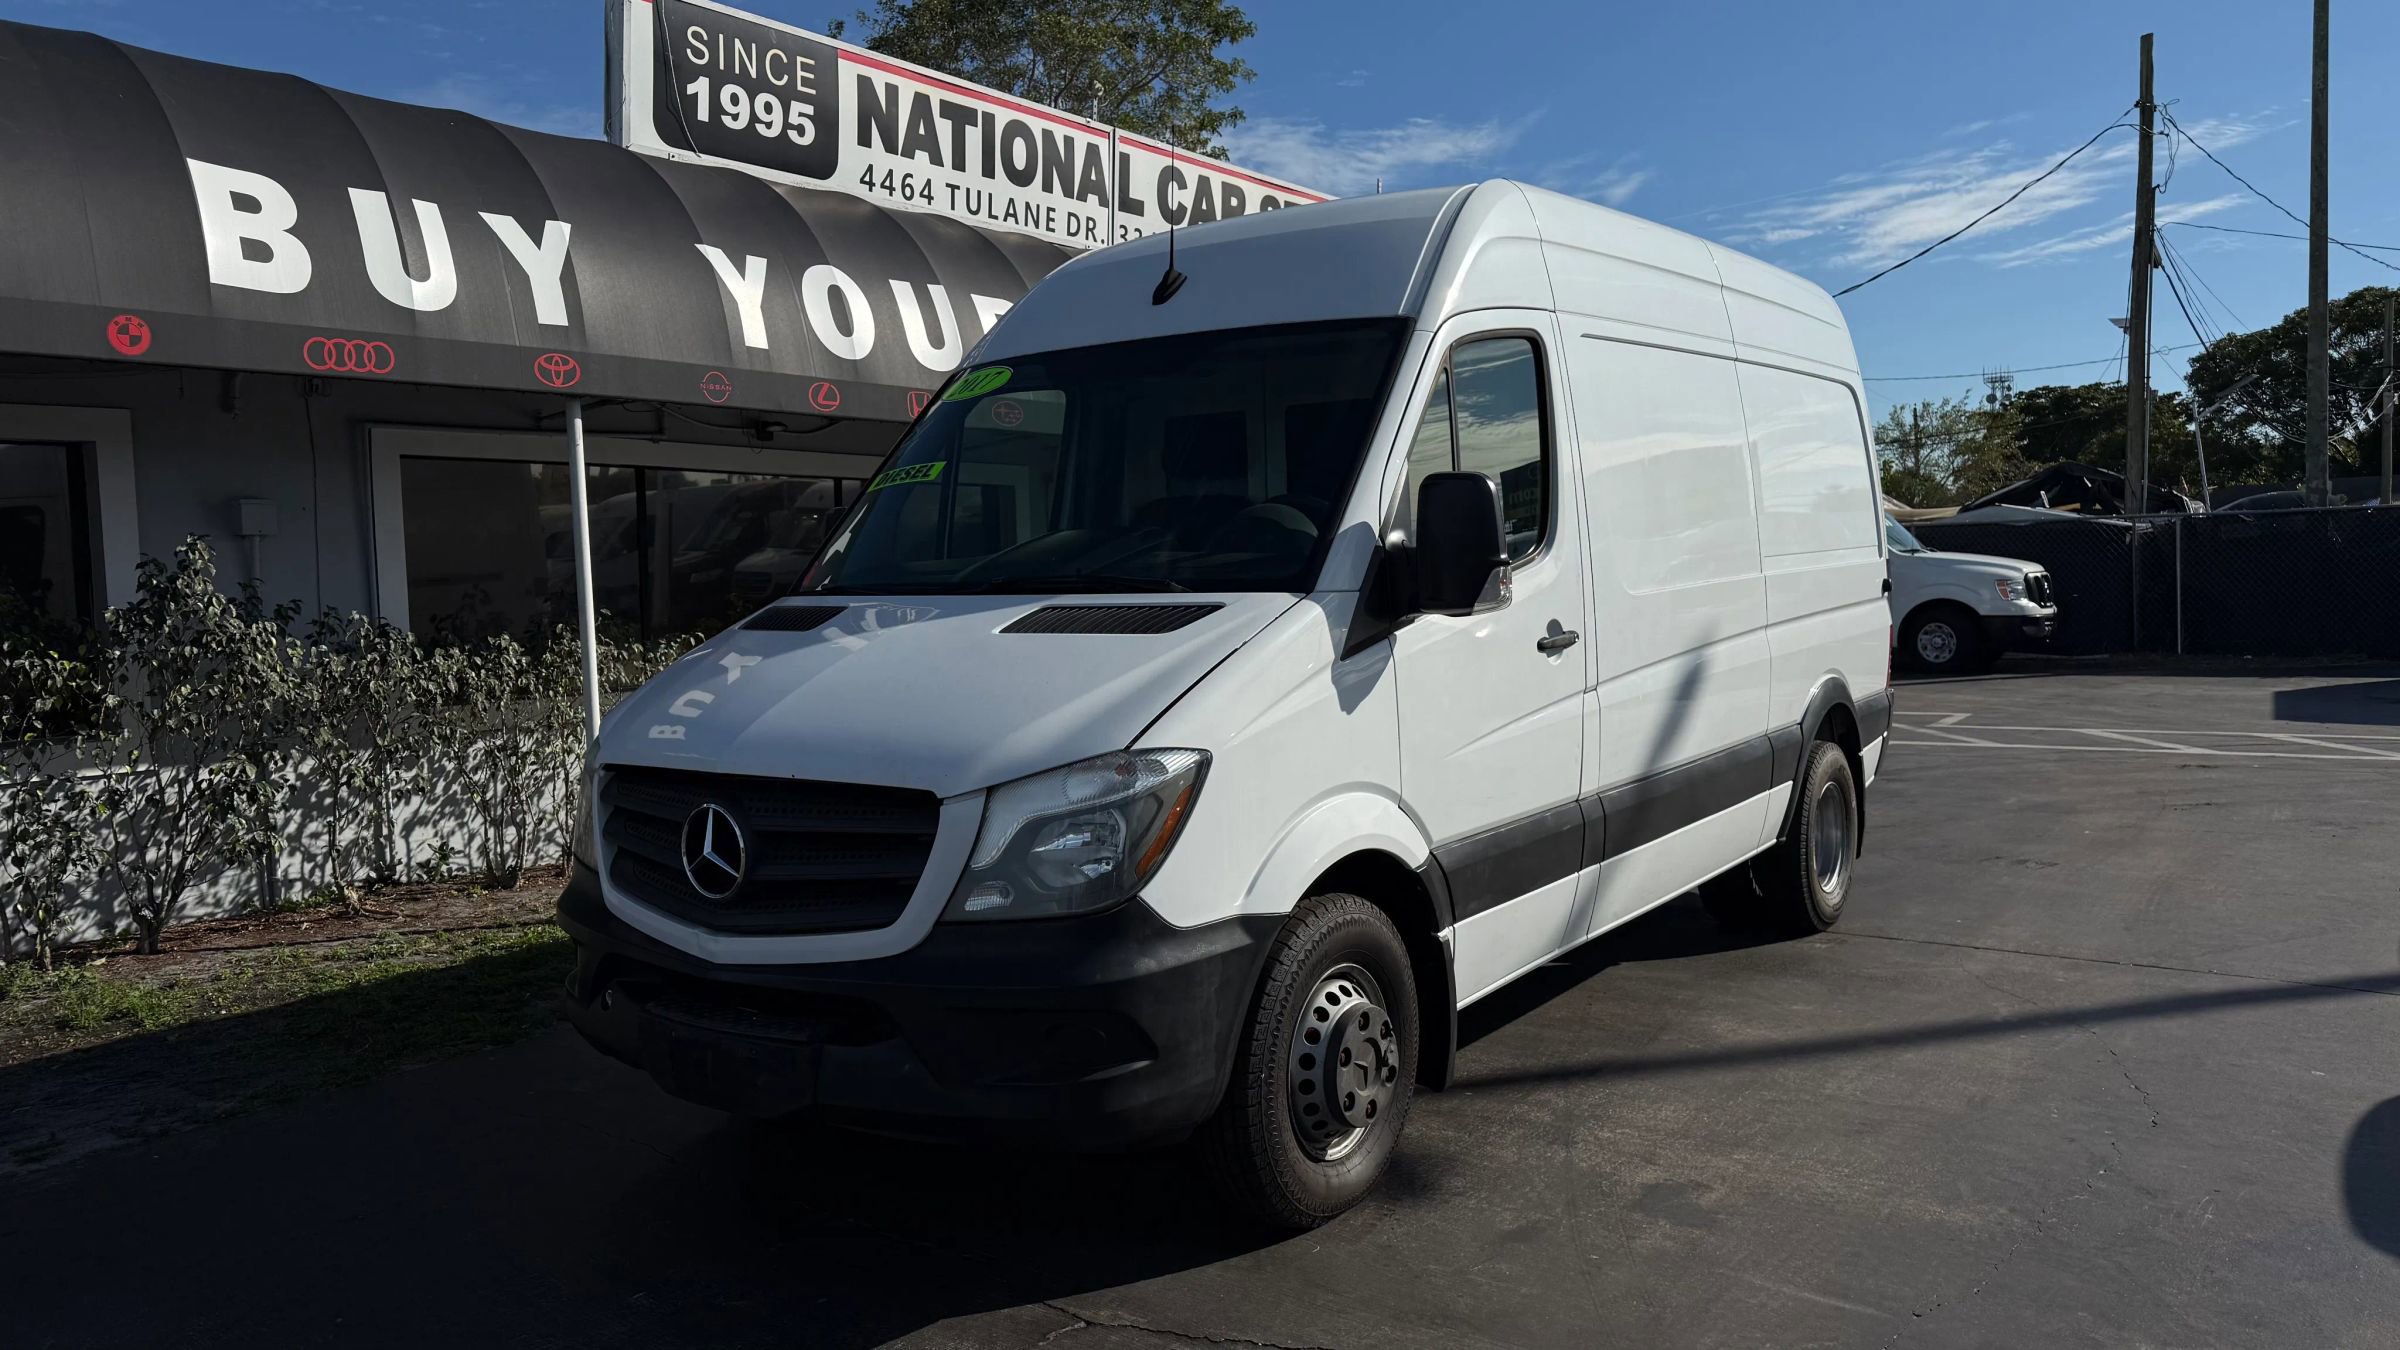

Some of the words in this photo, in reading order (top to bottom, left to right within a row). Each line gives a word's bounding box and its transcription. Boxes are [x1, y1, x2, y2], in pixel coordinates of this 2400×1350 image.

[686, 25, 817, 95] SINCE
[686, 75, 816, 146] 1995
[857, 73, 1145, 217] NATIONAL
[186, 157, 572, 326] BUY
[859, 163, 935, 206] 4464
[945, 182, 1057, 233] TULANE
[1066, 211, 1106, 244] DR.
[694, 243, 1014, 372] YOU
[699, 383, 732, 392] NISSAN
[873, 463, 936, 488] DIESEL
